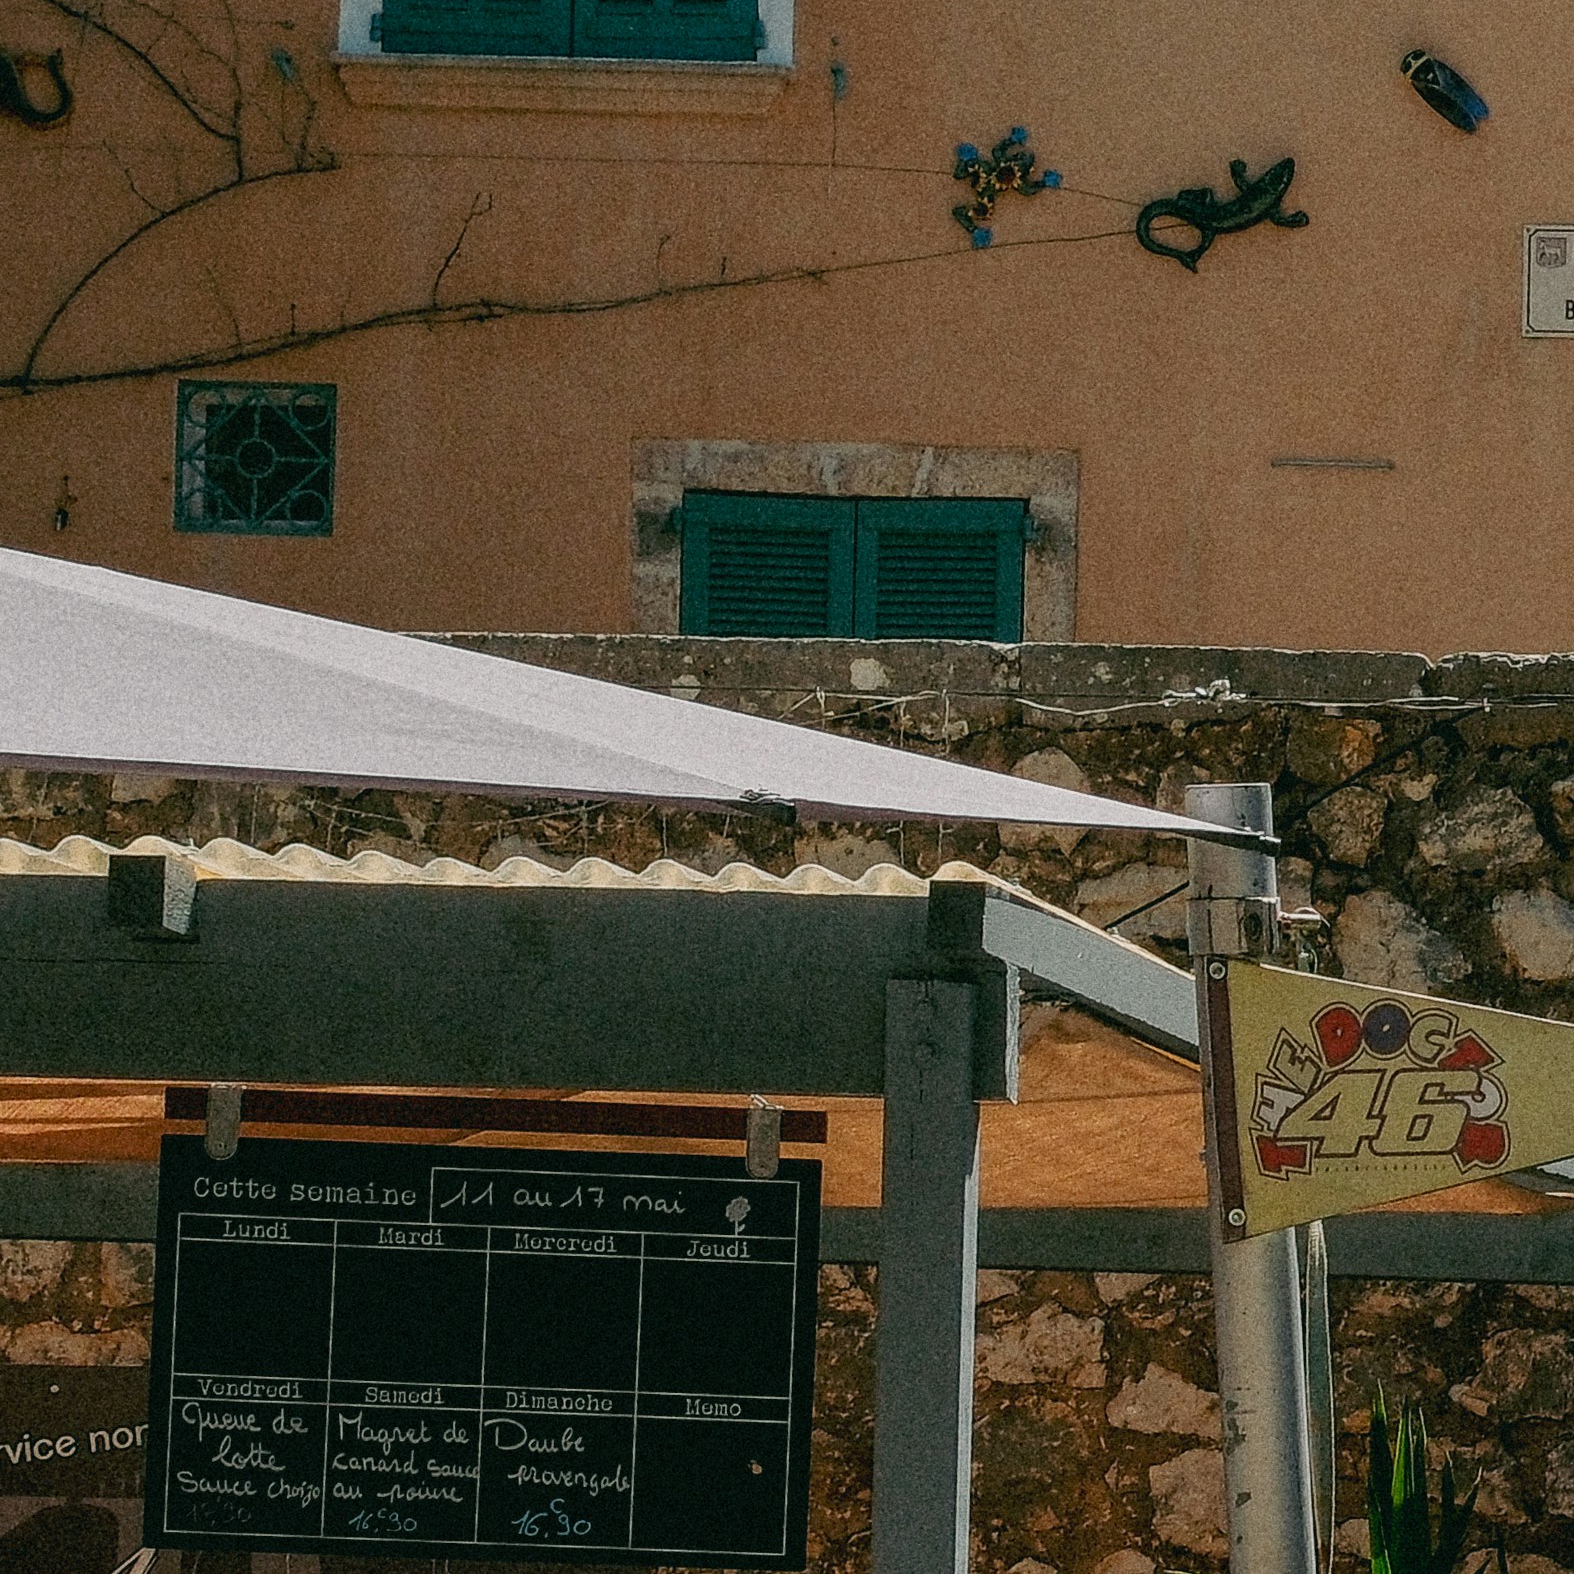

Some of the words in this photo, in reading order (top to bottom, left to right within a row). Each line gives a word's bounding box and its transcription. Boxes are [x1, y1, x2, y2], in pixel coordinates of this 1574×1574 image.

[1248, 1027, 1325, 1181] THE
[1273, 1067, 1485, 1159] 46
[194, 1177, 277, 1201] Cette
[290, 1181, 418, 1207] semaine
[438, 1181, 494, 1209] 11
[512, 1186, 553, 1207] au
[559, 1185, 604, 1209] 17
[622, 1191, 688, 1214] mai
[222, 1220, 291, 1240] Lundi
[378, 1225, 445, 1247] Mardi
[513, 1233, 618, 1254] Mercredi
[686, 1240, 751, 1259] Jeudi
[198, 1379, 304, 1399] Vendredi
[365, 1387, 446, 1404] Samedi
[505, 1392, 613, 1412] Dimanche
[182, 1401, 262, 1442] Queue
[272, 1408, 309, 1434] de
[685, 1398, 743, 1419] Memo
[338, 1410, 432, 1456] Magret
[443, 1420, 470, 1444] de
[484, 1418, 585, 1453] Daube
[212, 1435, 286, 1471] lotte
[176, 1471, 260, 1497] Sauce
